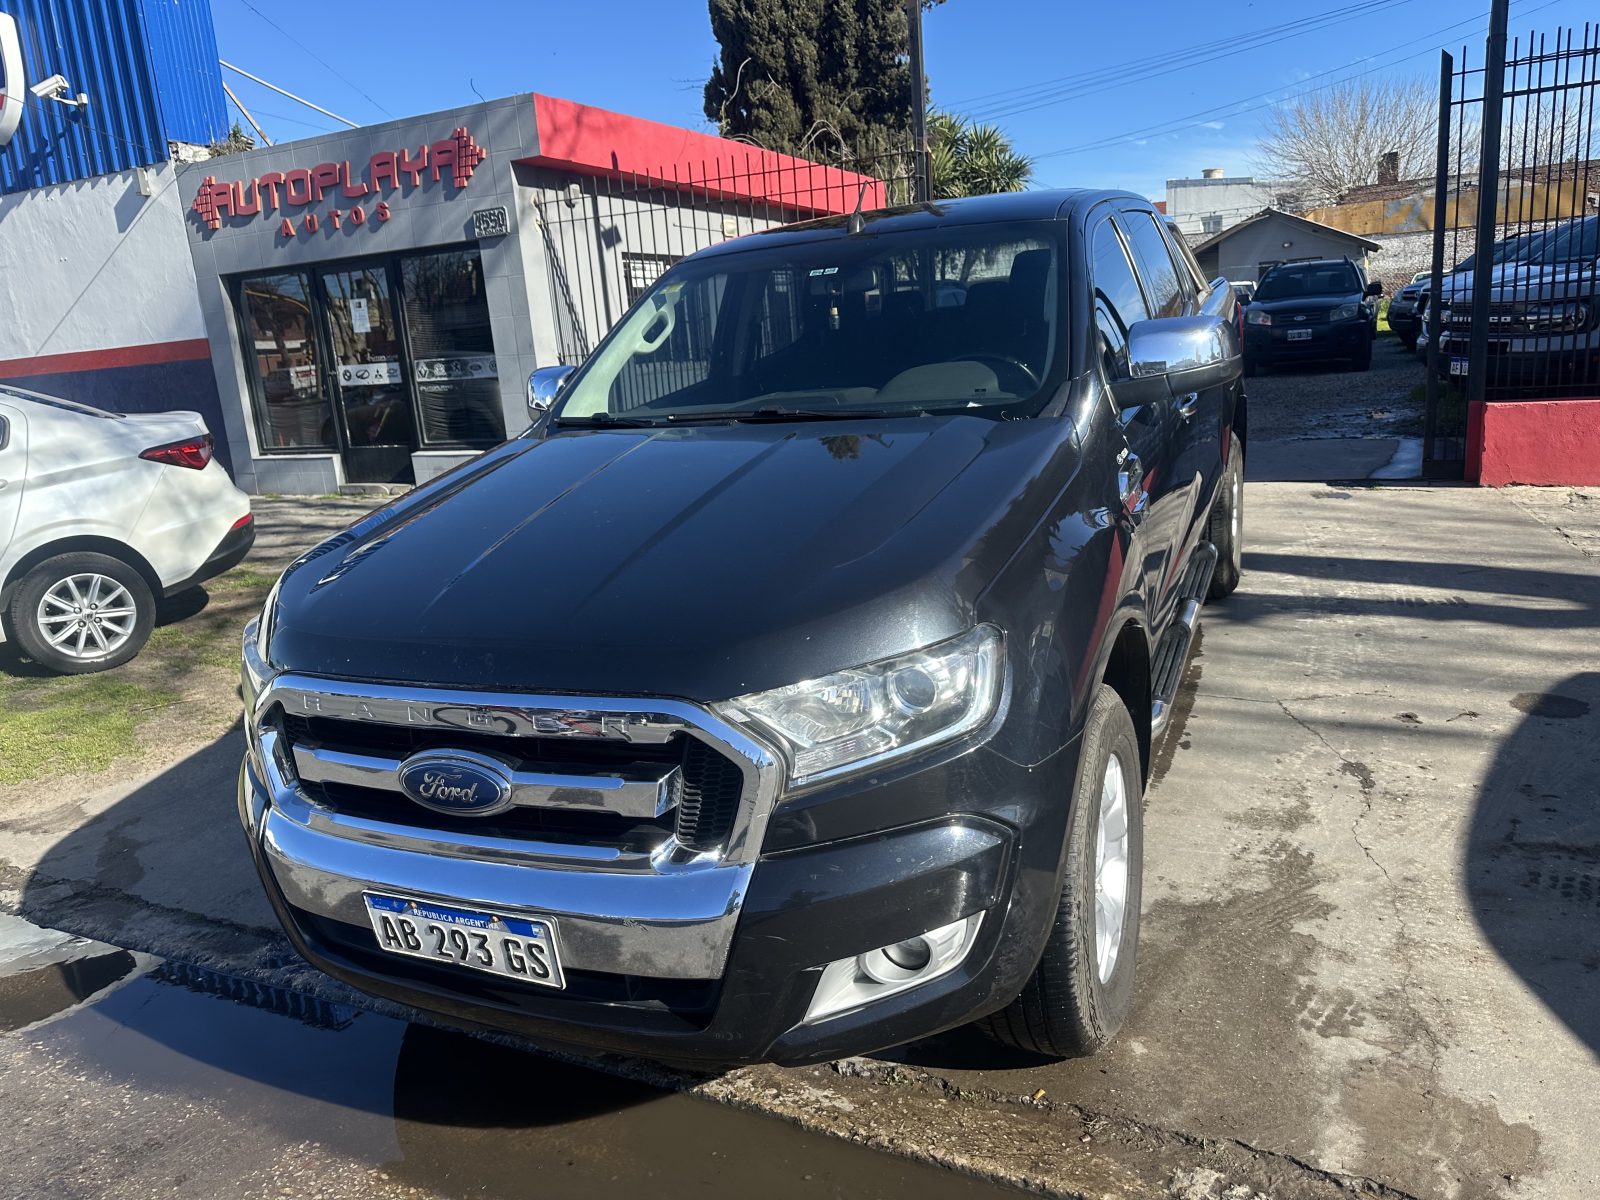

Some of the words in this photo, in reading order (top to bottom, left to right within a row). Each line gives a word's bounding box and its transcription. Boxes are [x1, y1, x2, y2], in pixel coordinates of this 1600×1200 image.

[211, 139, 459, 217] AUTOPLAYA
[281, 201, 391, 237] AUTOS
[303, 694, 630, 734] RANGER
[420, 769, 478, 802] Ford
[381, 915, 422, 951] AB
[428, 925, 494, 967] 293
[503, 938, 550, 979] GS
